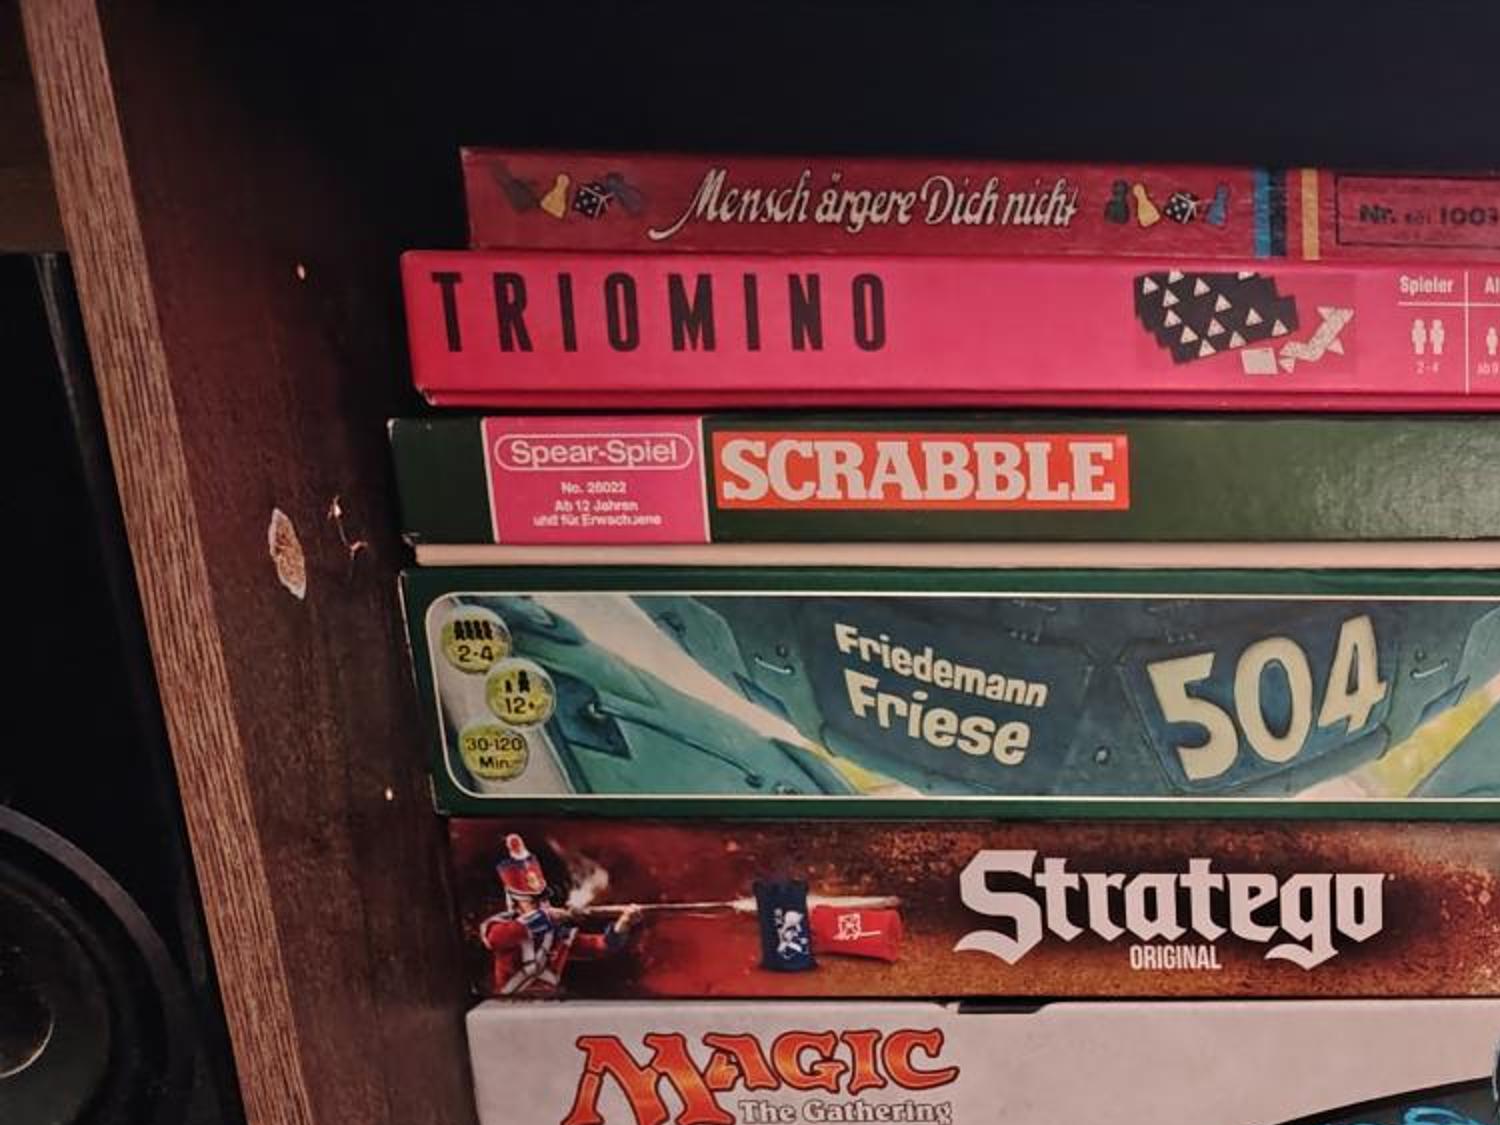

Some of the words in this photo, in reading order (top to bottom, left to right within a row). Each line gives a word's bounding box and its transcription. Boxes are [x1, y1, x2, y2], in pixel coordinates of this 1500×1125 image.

[648, 168, 811, 240] Mensch
[815, 173, 912, 232] ärgere
[921, 175, 999, 225] Dich
[1001, 177, 1077, 227] nicht
[1399, 275, 1453, 294] Spieler
[431, 271, 887, 353] TRIOMINO
[511, 438, 677, 468] Spear-Spiel
[721, 438, 1116, 502] SCRABBLE
[555, 500, 573, 512] Ab
[593, 499, 639, 512] Jahren
[458, 645, 495, 663] 2-4
[834, 622, 1048, 708] Friedemann
[842, 669, 1031, 766] Friese
[1146, 613, 1388, 781] 504
[465, 737, 523, 752] 30-120
[953, 848, 1385, 971] Stratego
[1129, 943, 1223, 971] ORIGINAL
[739, 1100, 796, 1124] The
